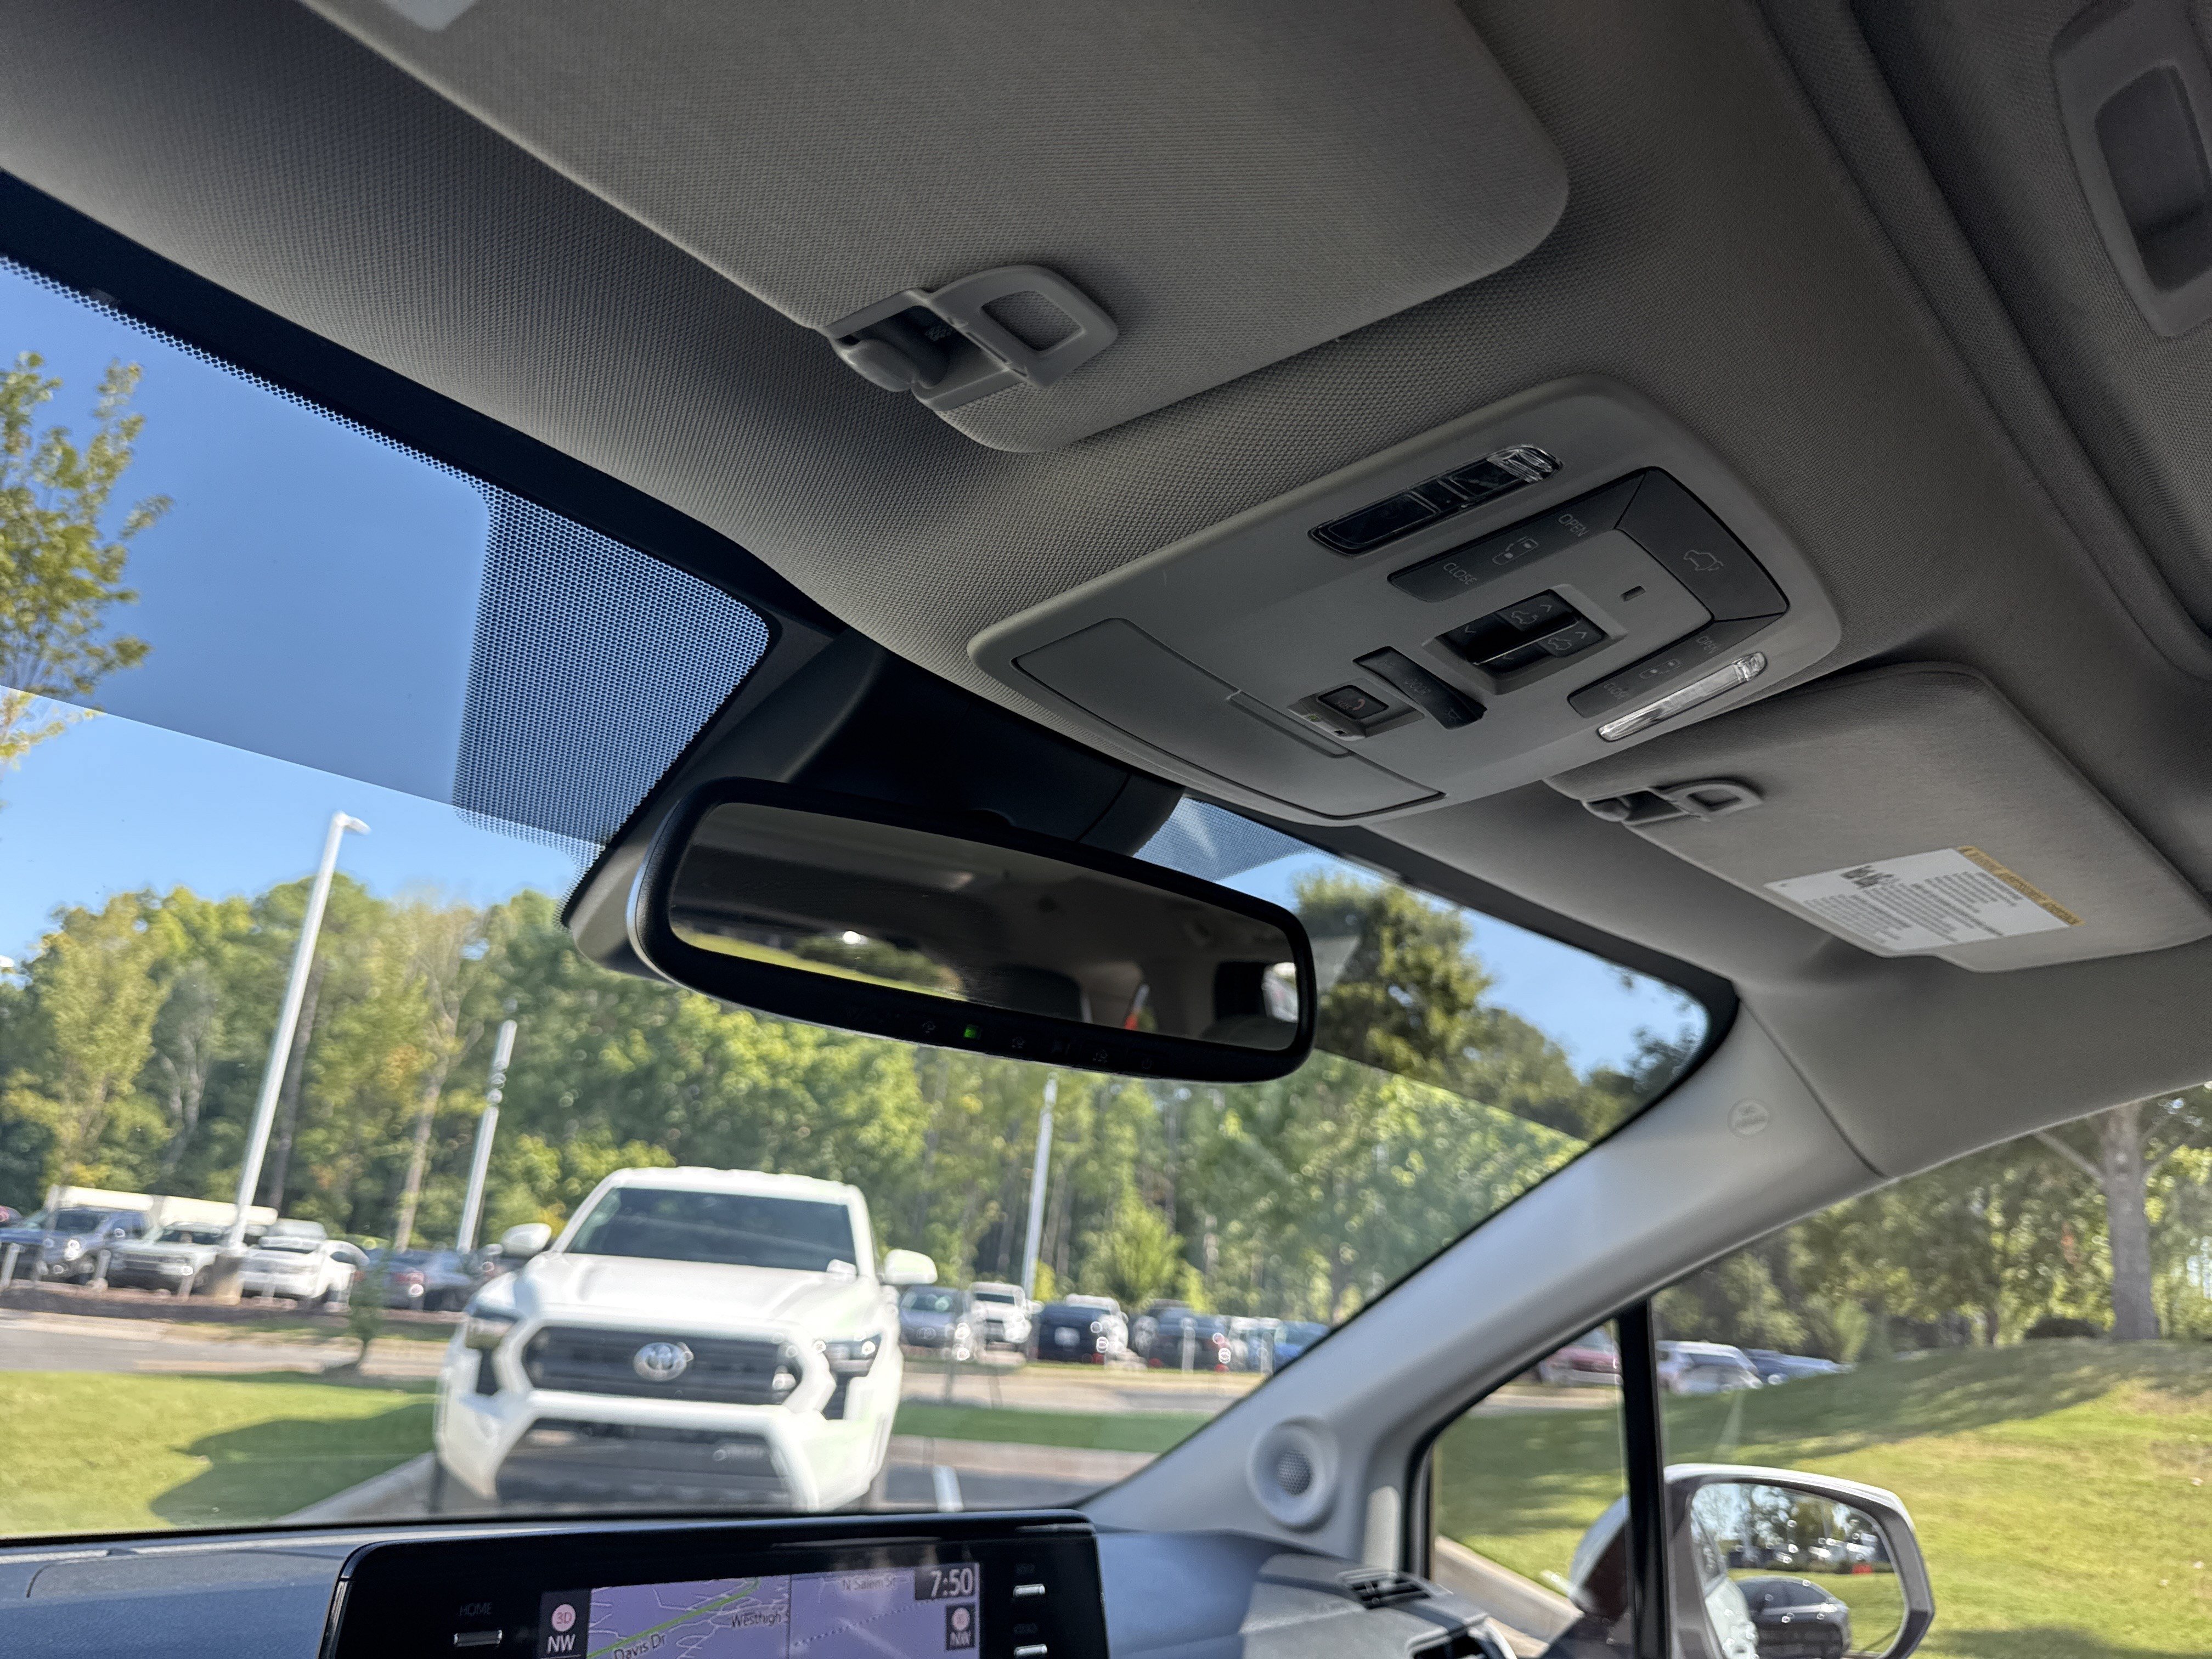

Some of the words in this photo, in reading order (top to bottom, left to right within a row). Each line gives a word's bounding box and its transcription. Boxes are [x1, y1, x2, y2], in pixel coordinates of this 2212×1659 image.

[1558, 513, 1590, 537] OPEN
[1443, 562, 1477, 585] CLOSE
[1696, 635, 1718, 654] OPEN
[1604, 682, 1629, 701] CLOSE
[843, 1579, 851, 1591] N
[930, 1567, 973, 1598] 7:50
[459, 1601, 493, 1616] HOME
[556, 1611, 572, 1624] 3D
[546, 1634, 575, 1655] NW
[614, 1641, 650, 1659] Davis
[650, 1633, 666, 1649] Dr
[950, 1630, 972, 1647] NW
